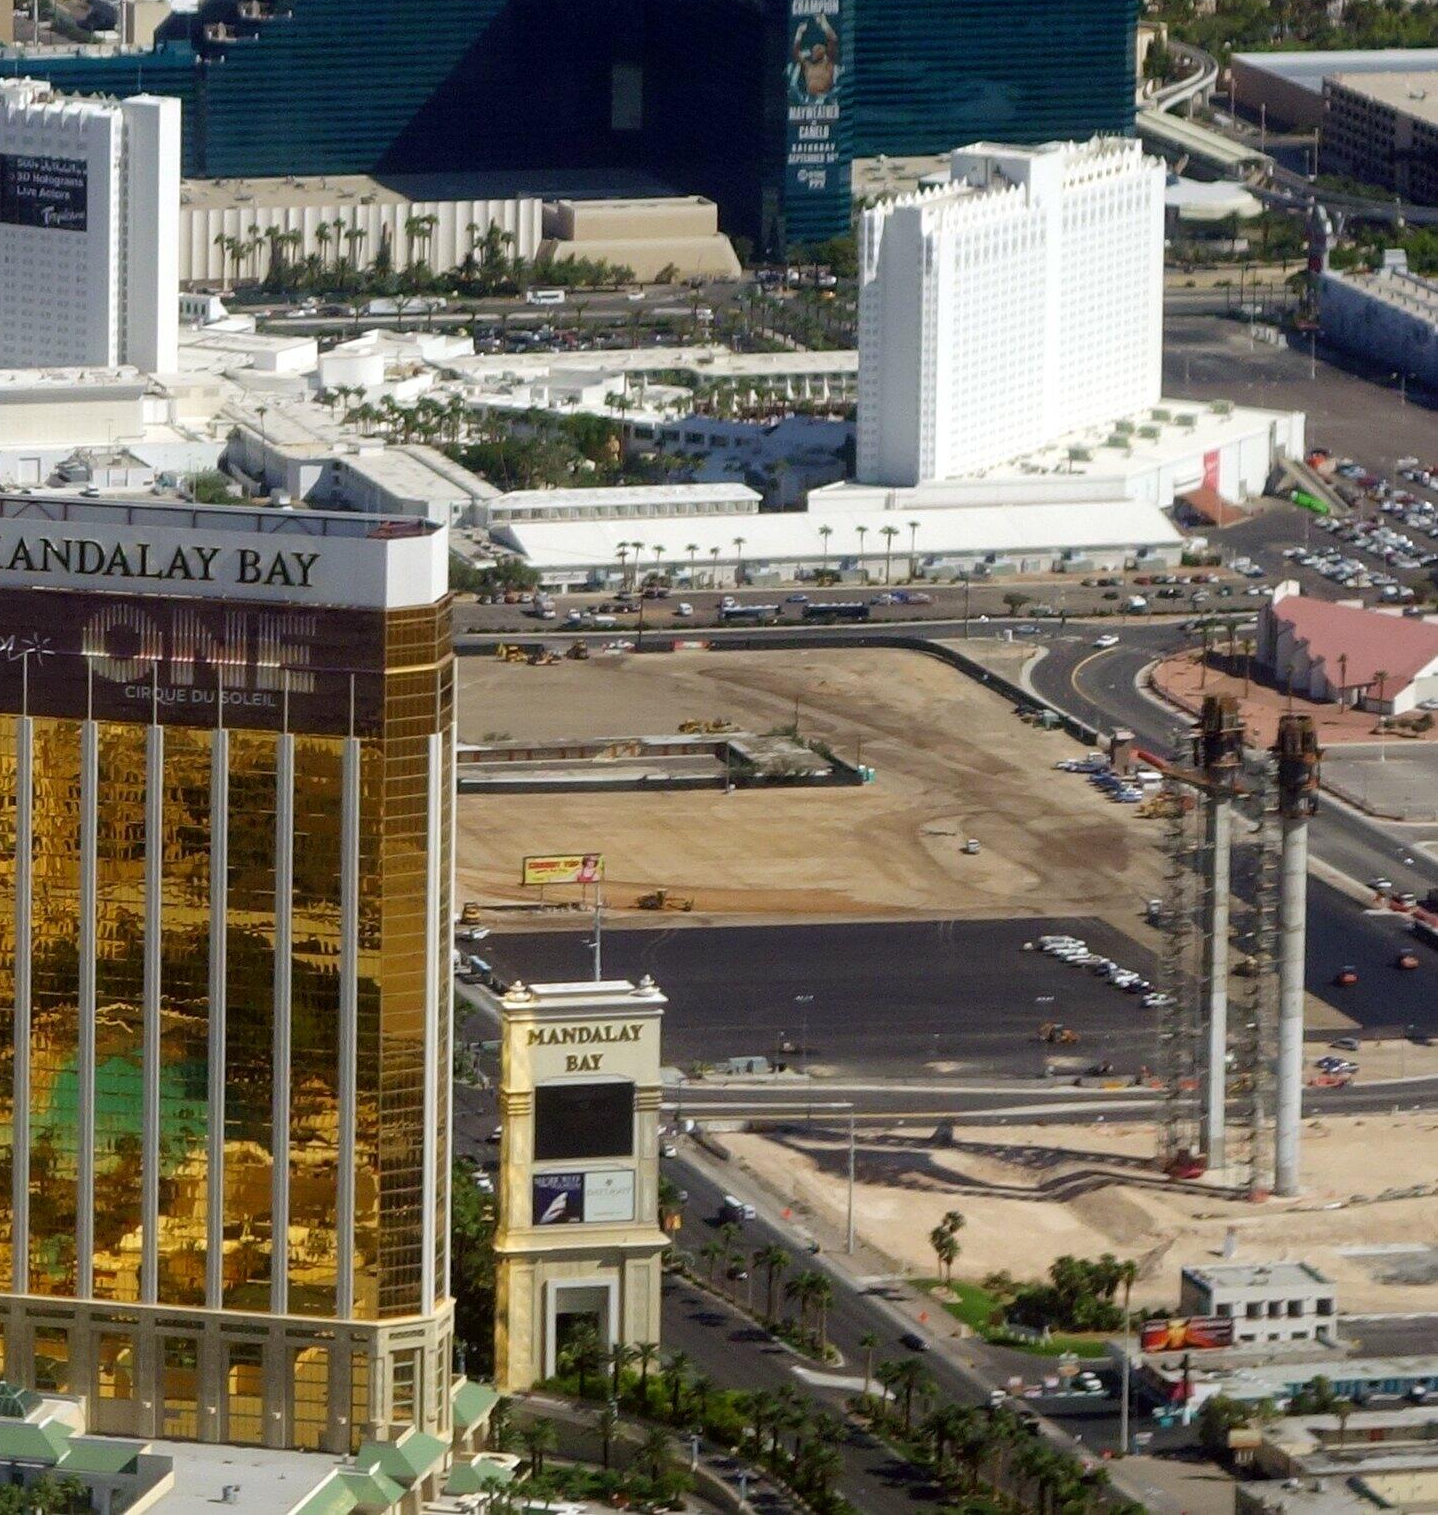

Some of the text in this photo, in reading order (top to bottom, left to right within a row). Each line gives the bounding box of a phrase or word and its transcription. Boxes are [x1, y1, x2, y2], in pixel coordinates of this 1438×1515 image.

[17, 171, 84, 187] 3D Holograms
[17, 185, 71, 200] Live Actors
[236, 548, 321, 587] BAY
[81, 603, 317, 693] ONE
[124, 686, 277, 707] CIRQUE DU SOLEIL
[527, 1024, 645, 1046] MANDALAY
[565, 1053, 604, 1073] BAY
